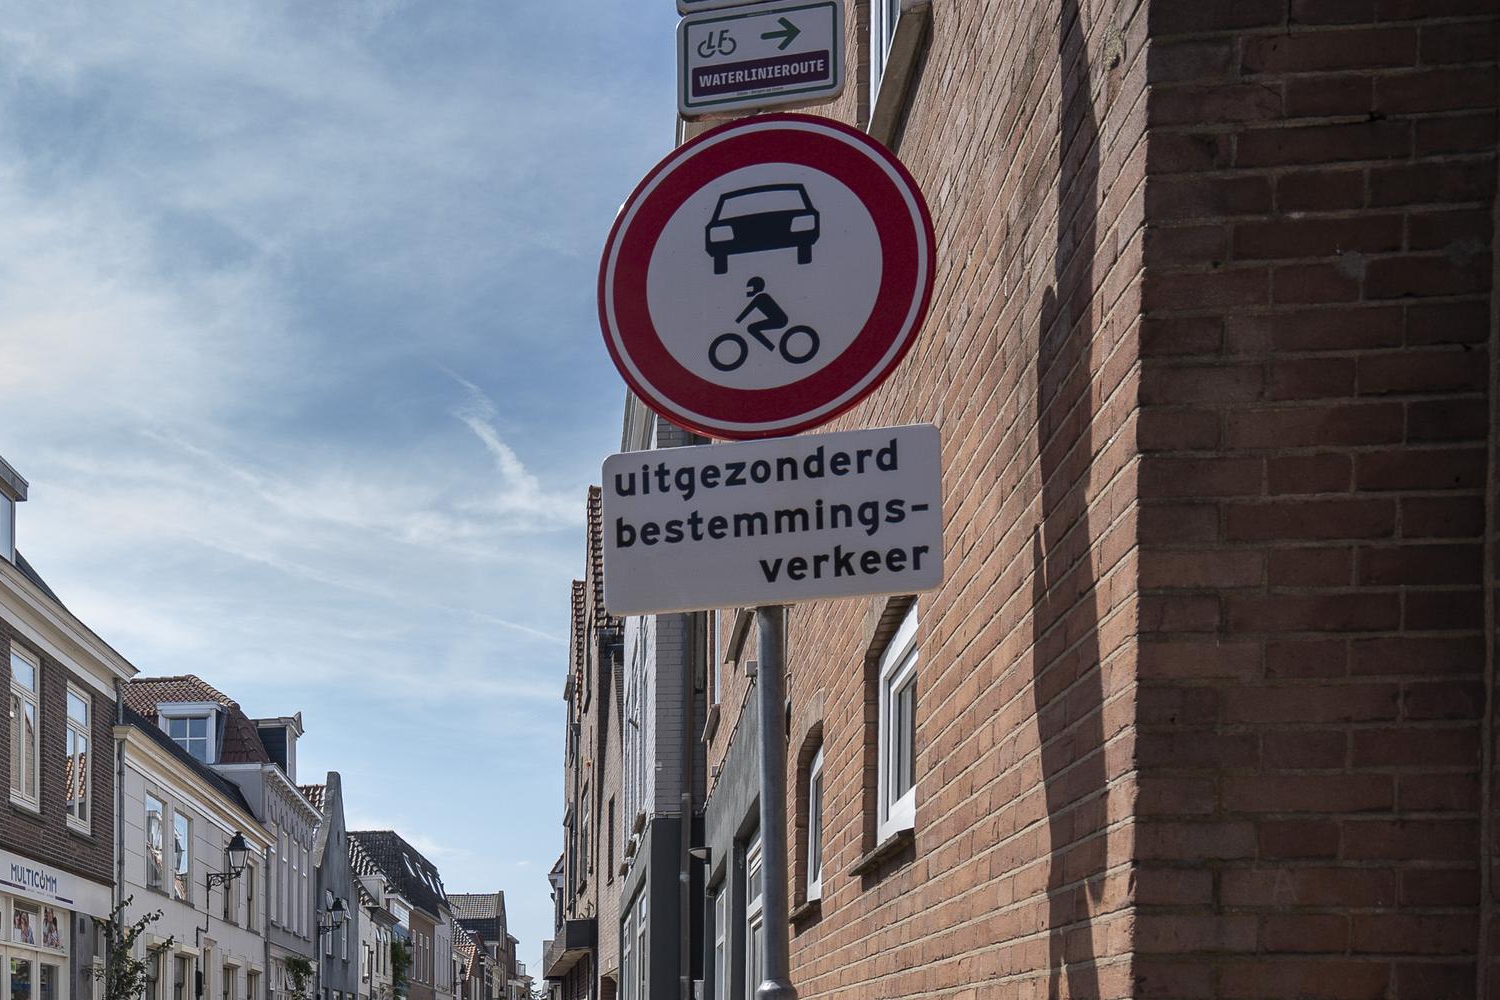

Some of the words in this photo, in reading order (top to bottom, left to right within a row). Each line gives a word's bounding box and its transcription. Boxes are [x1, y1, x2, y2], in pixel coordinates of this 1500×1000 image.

[699, 59, 825, 88] WATERLINIEROUTE
[614, 438, 898, 501] uitgezonderd
[615, 498, 930, 549] bestemmings-
[759, 544, 930, 583] verkeer
